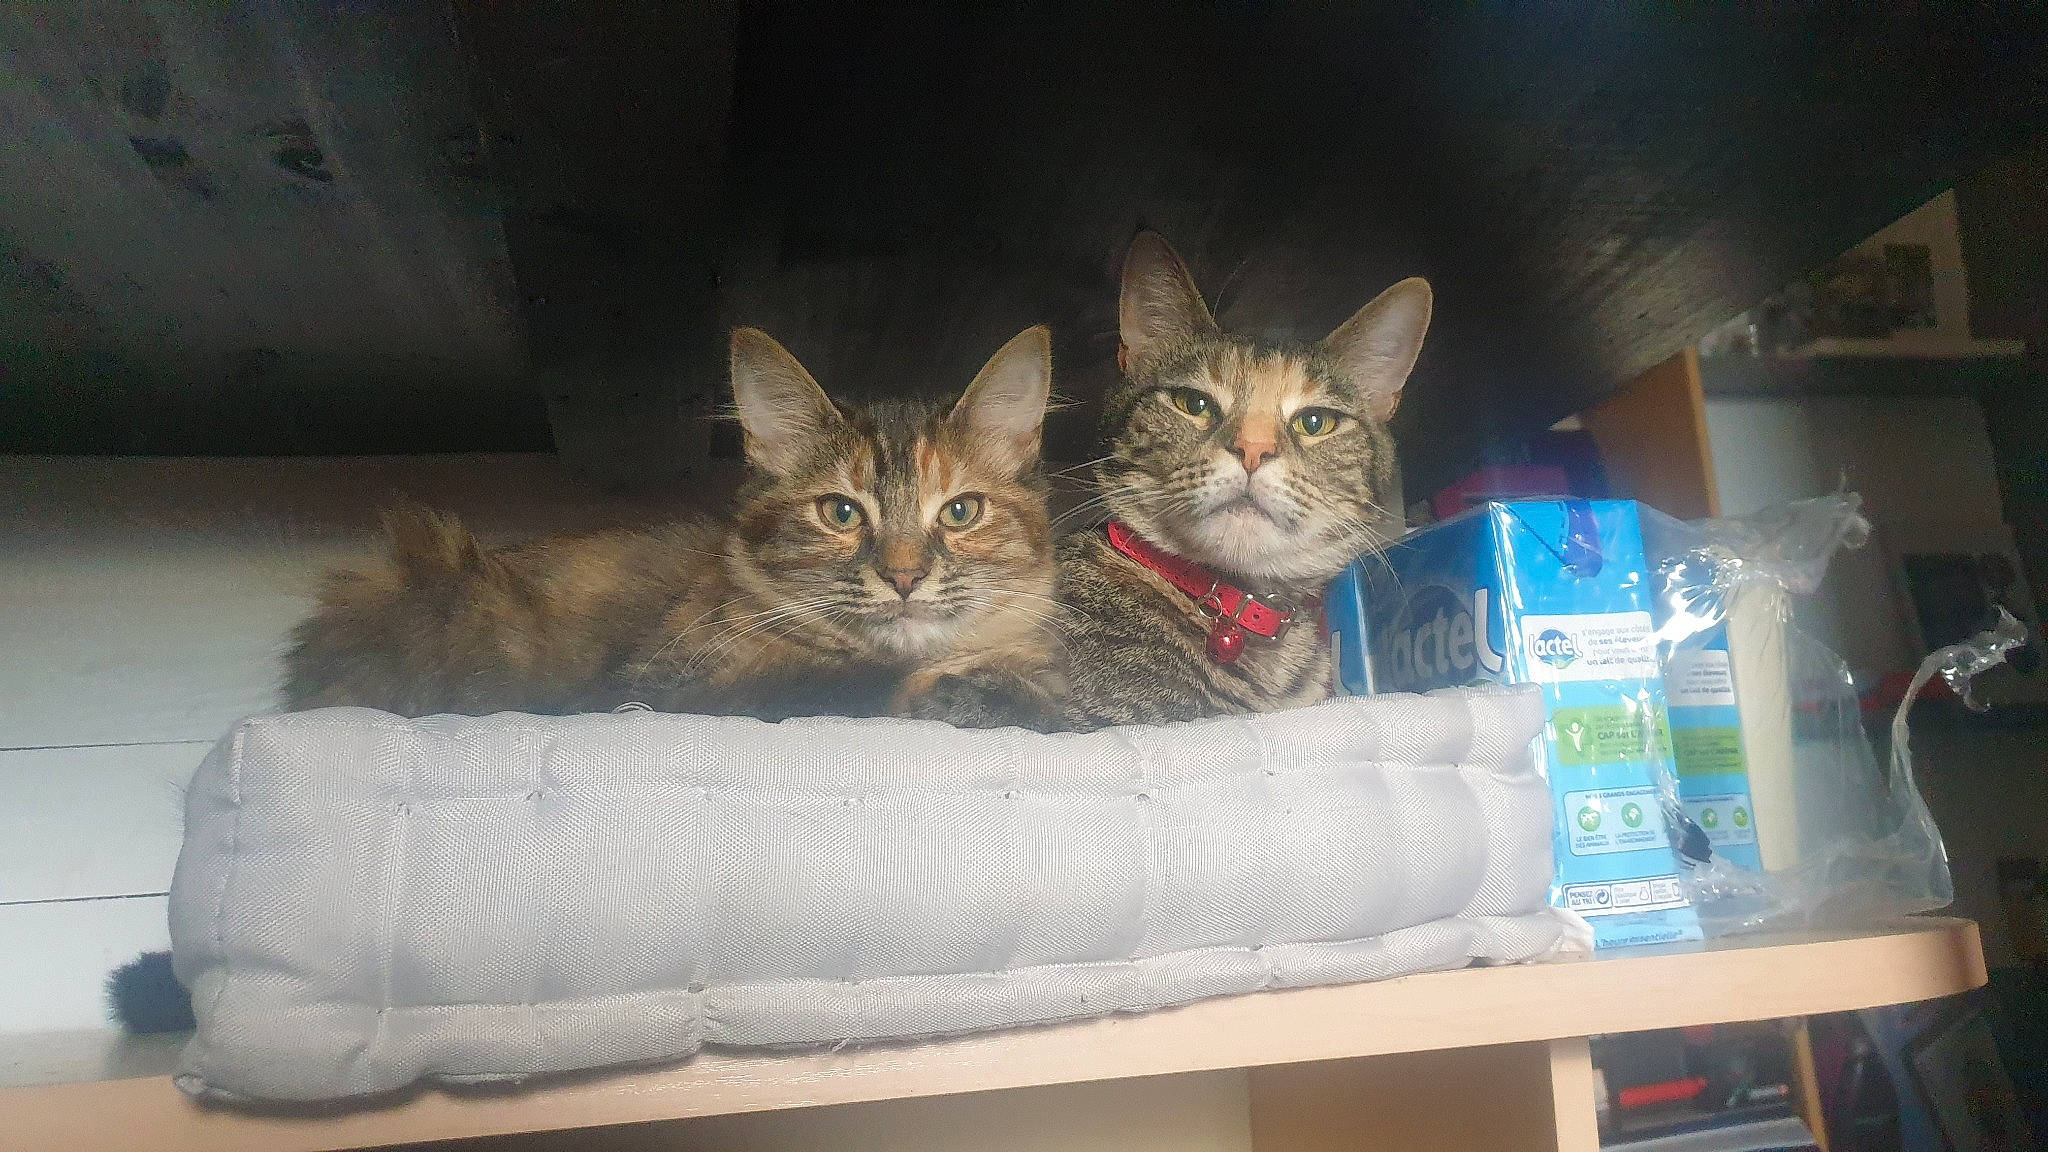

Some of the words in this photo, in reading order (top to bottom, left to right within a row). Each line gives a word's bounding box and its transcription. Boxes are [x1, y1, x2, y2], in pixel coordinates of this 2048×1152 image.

[1376, 587, 1503, 690] actel
[1528, 633, 1583, 660] lactel
[1569, 890, 1593, 898] PENSEZ
